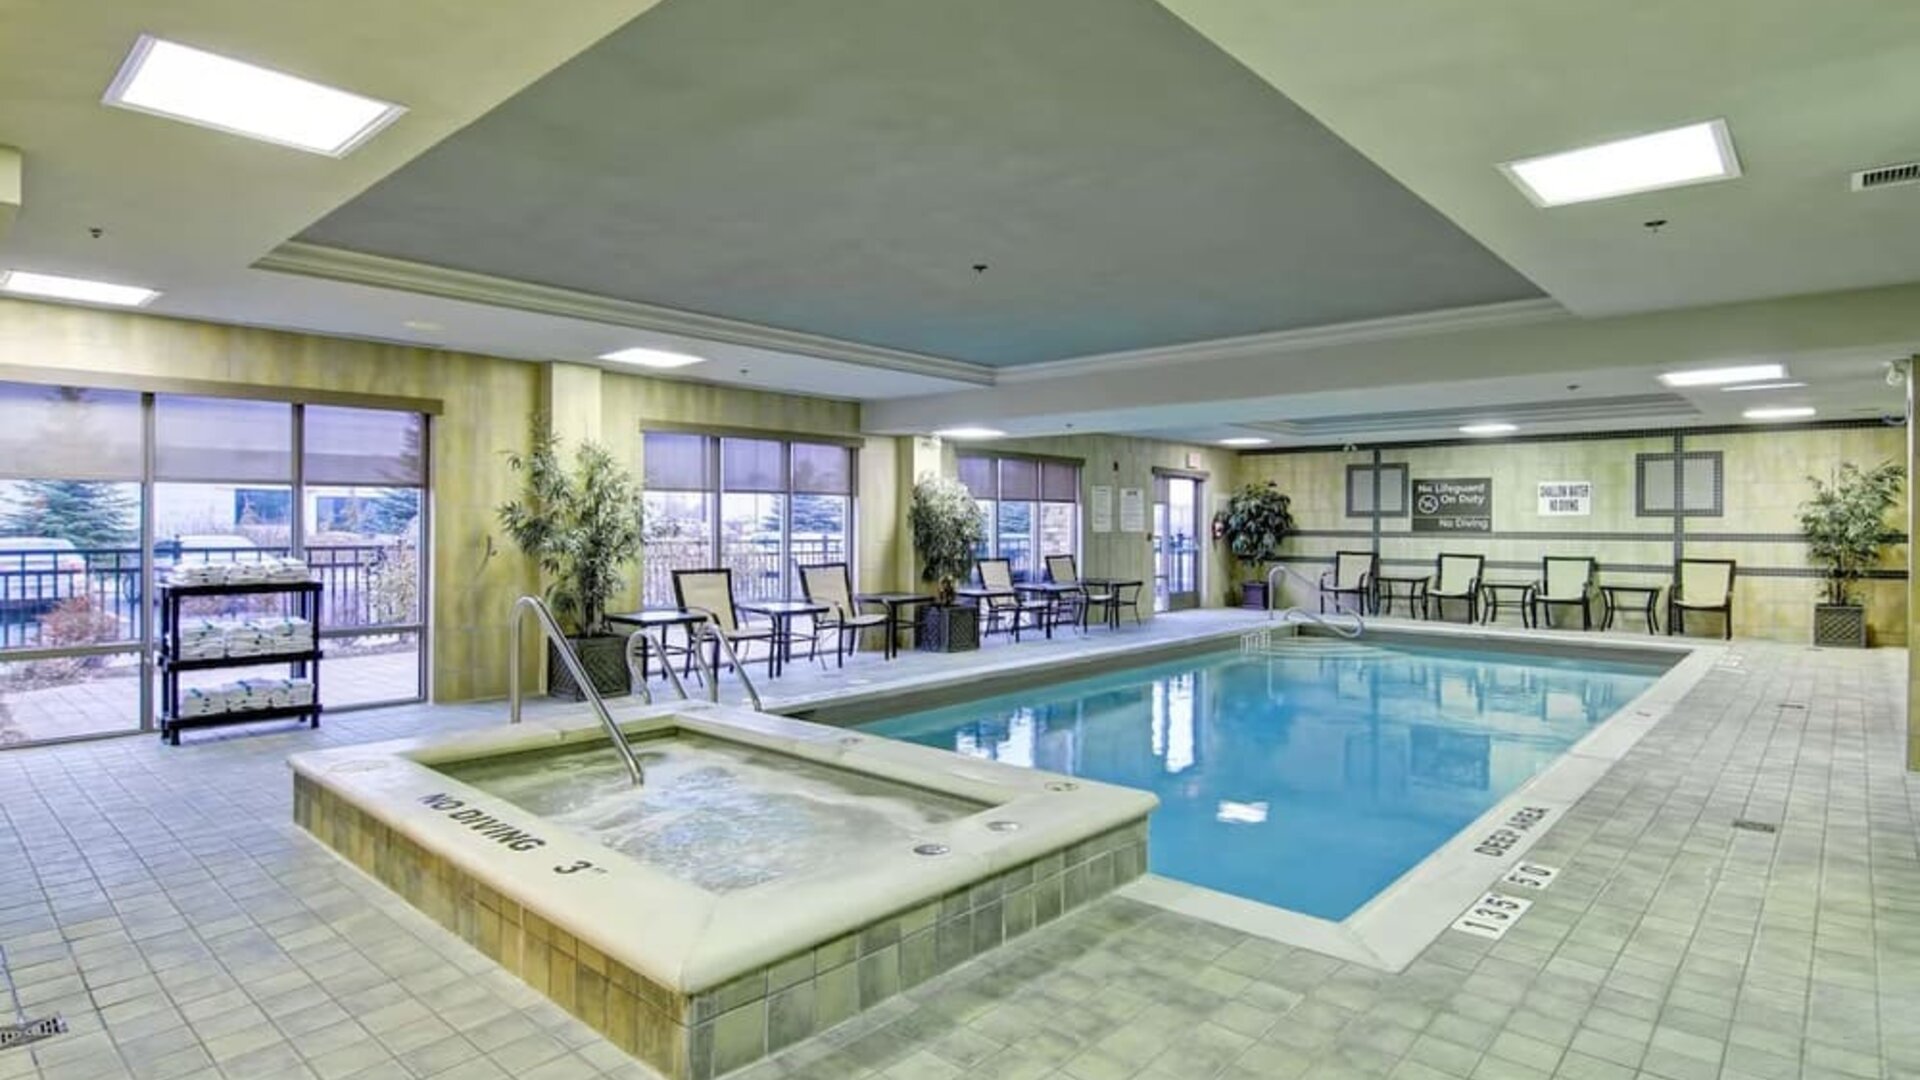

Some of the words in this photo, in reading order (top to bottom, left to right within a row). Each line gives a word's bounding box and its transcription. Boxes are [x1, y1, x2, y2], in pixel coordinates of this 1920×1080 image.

[1418, 484, 1432, 493] No
[1435, 483, 1485, 494] Lifeguard
[1440, 494, 1456, 504] On
[1459, 494, 1485, 505] Duty
[1440, 519, 1453, 528] No
[1456, 519, 1488, 530] Diving
[420, 793, 464, 811] NO
[449, 809, 546, 851] DIVING
[1474, 829, 1521, 857] DEEP
[1505, 806, 1550, 831] AREA
